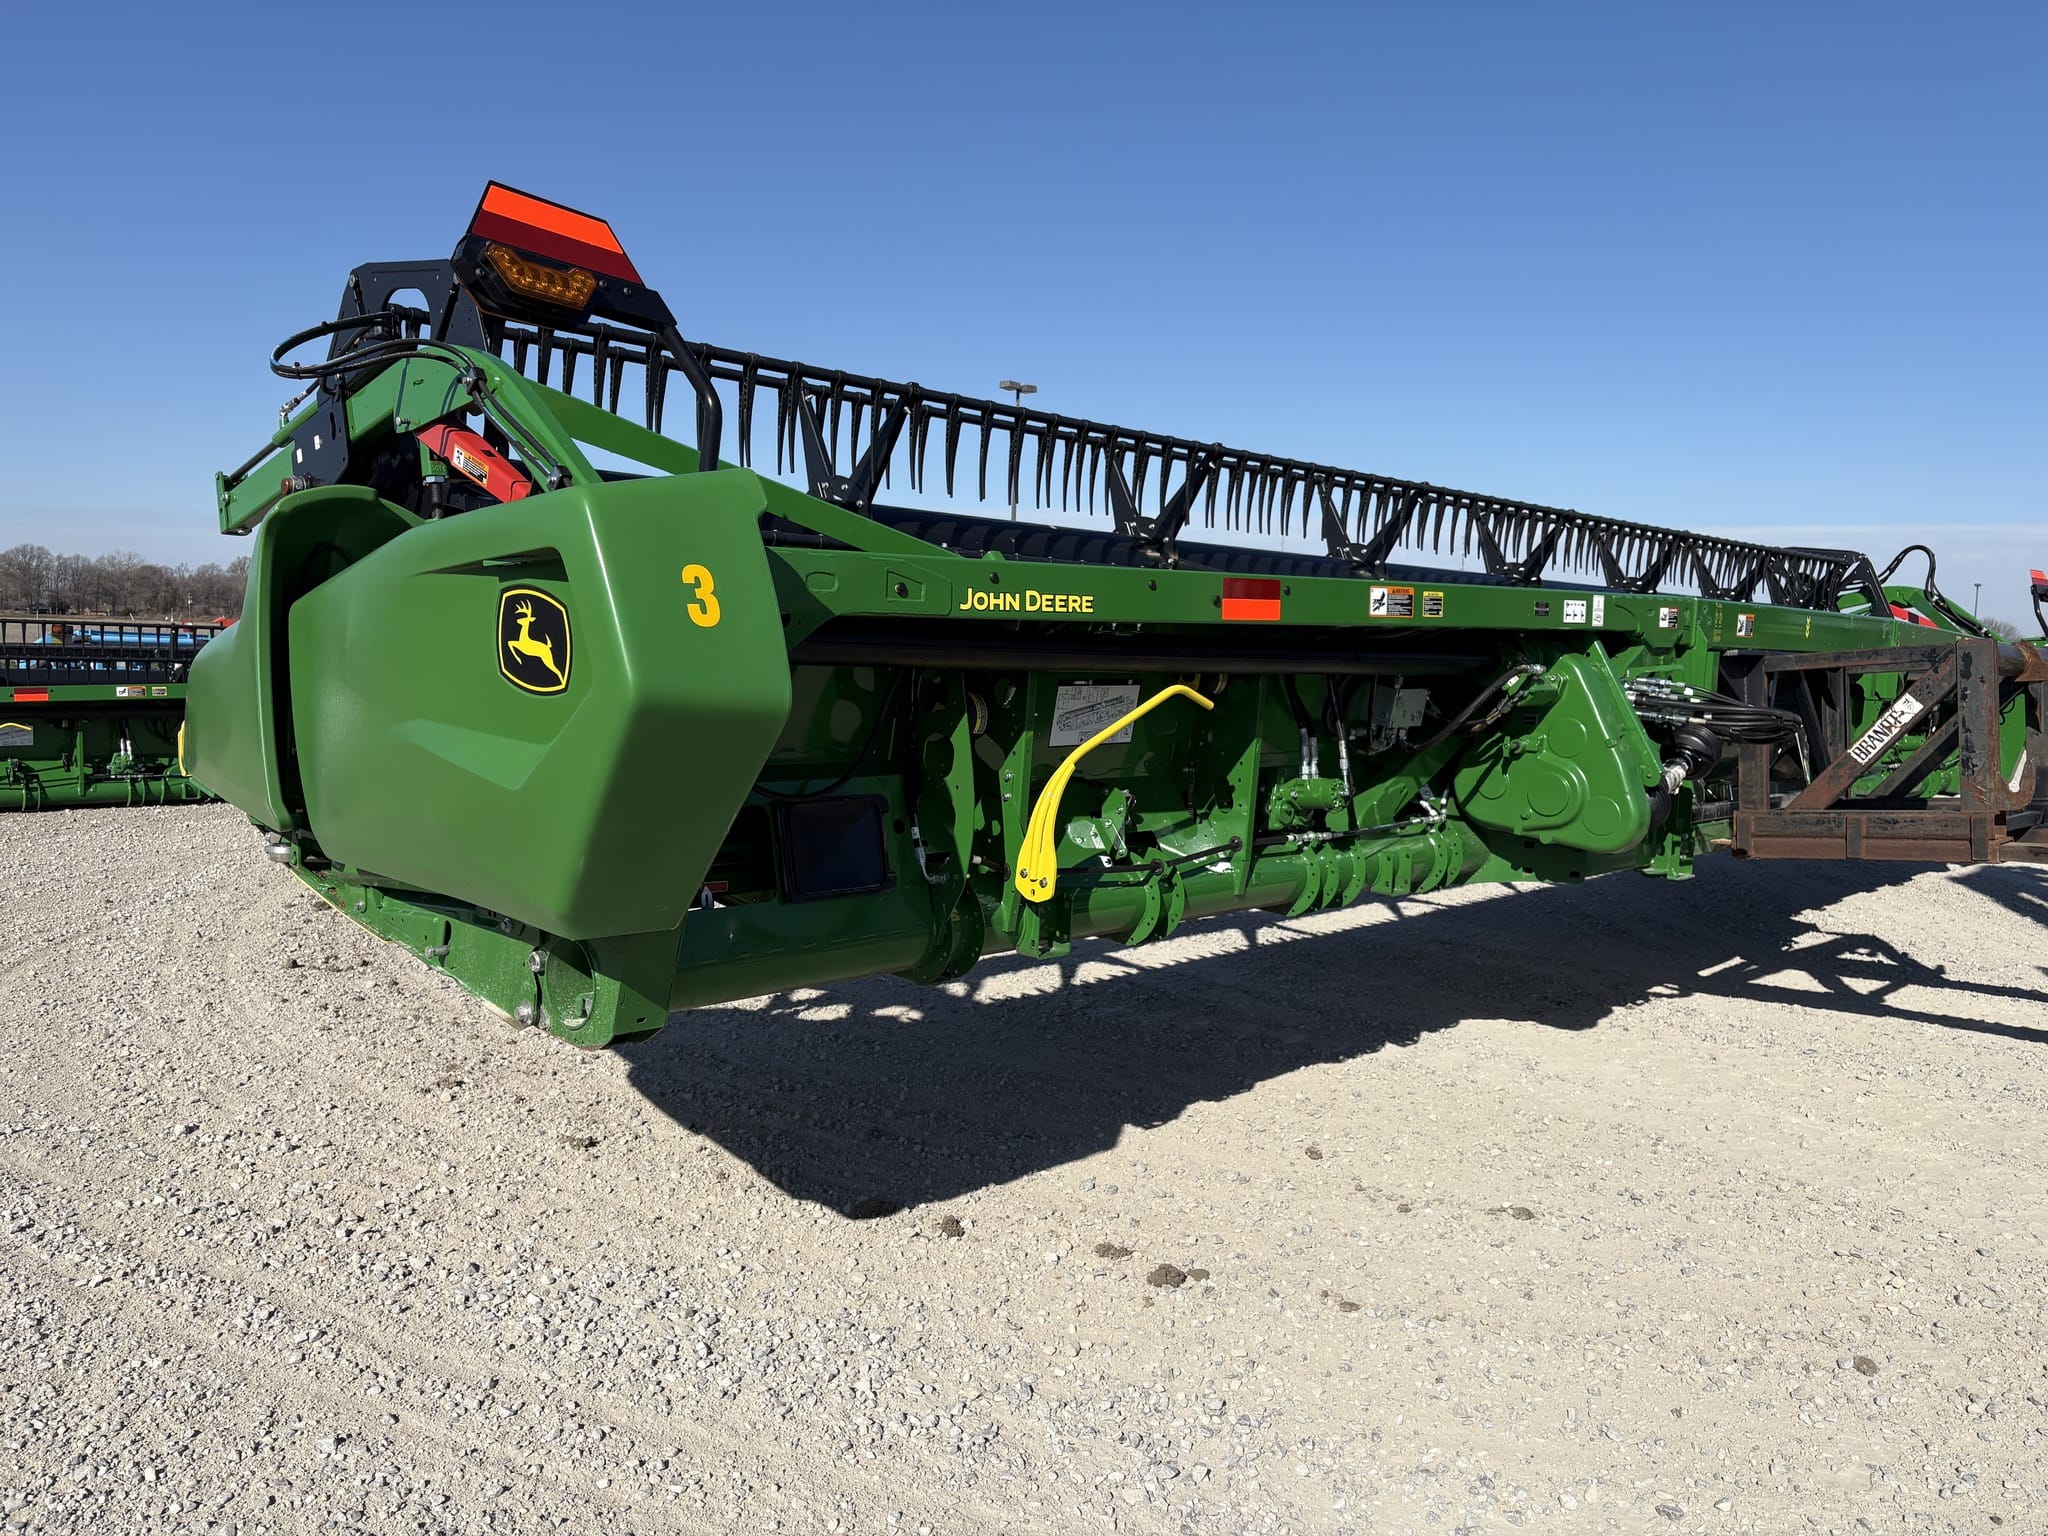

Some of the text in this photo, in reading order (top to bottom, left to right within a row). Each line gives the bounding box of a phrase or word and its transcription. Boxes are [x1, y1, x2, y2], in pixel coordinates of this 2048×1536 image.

[681, 564, 721, 628] 3
[959, 587, 1094, 613] JOHN DEERE
